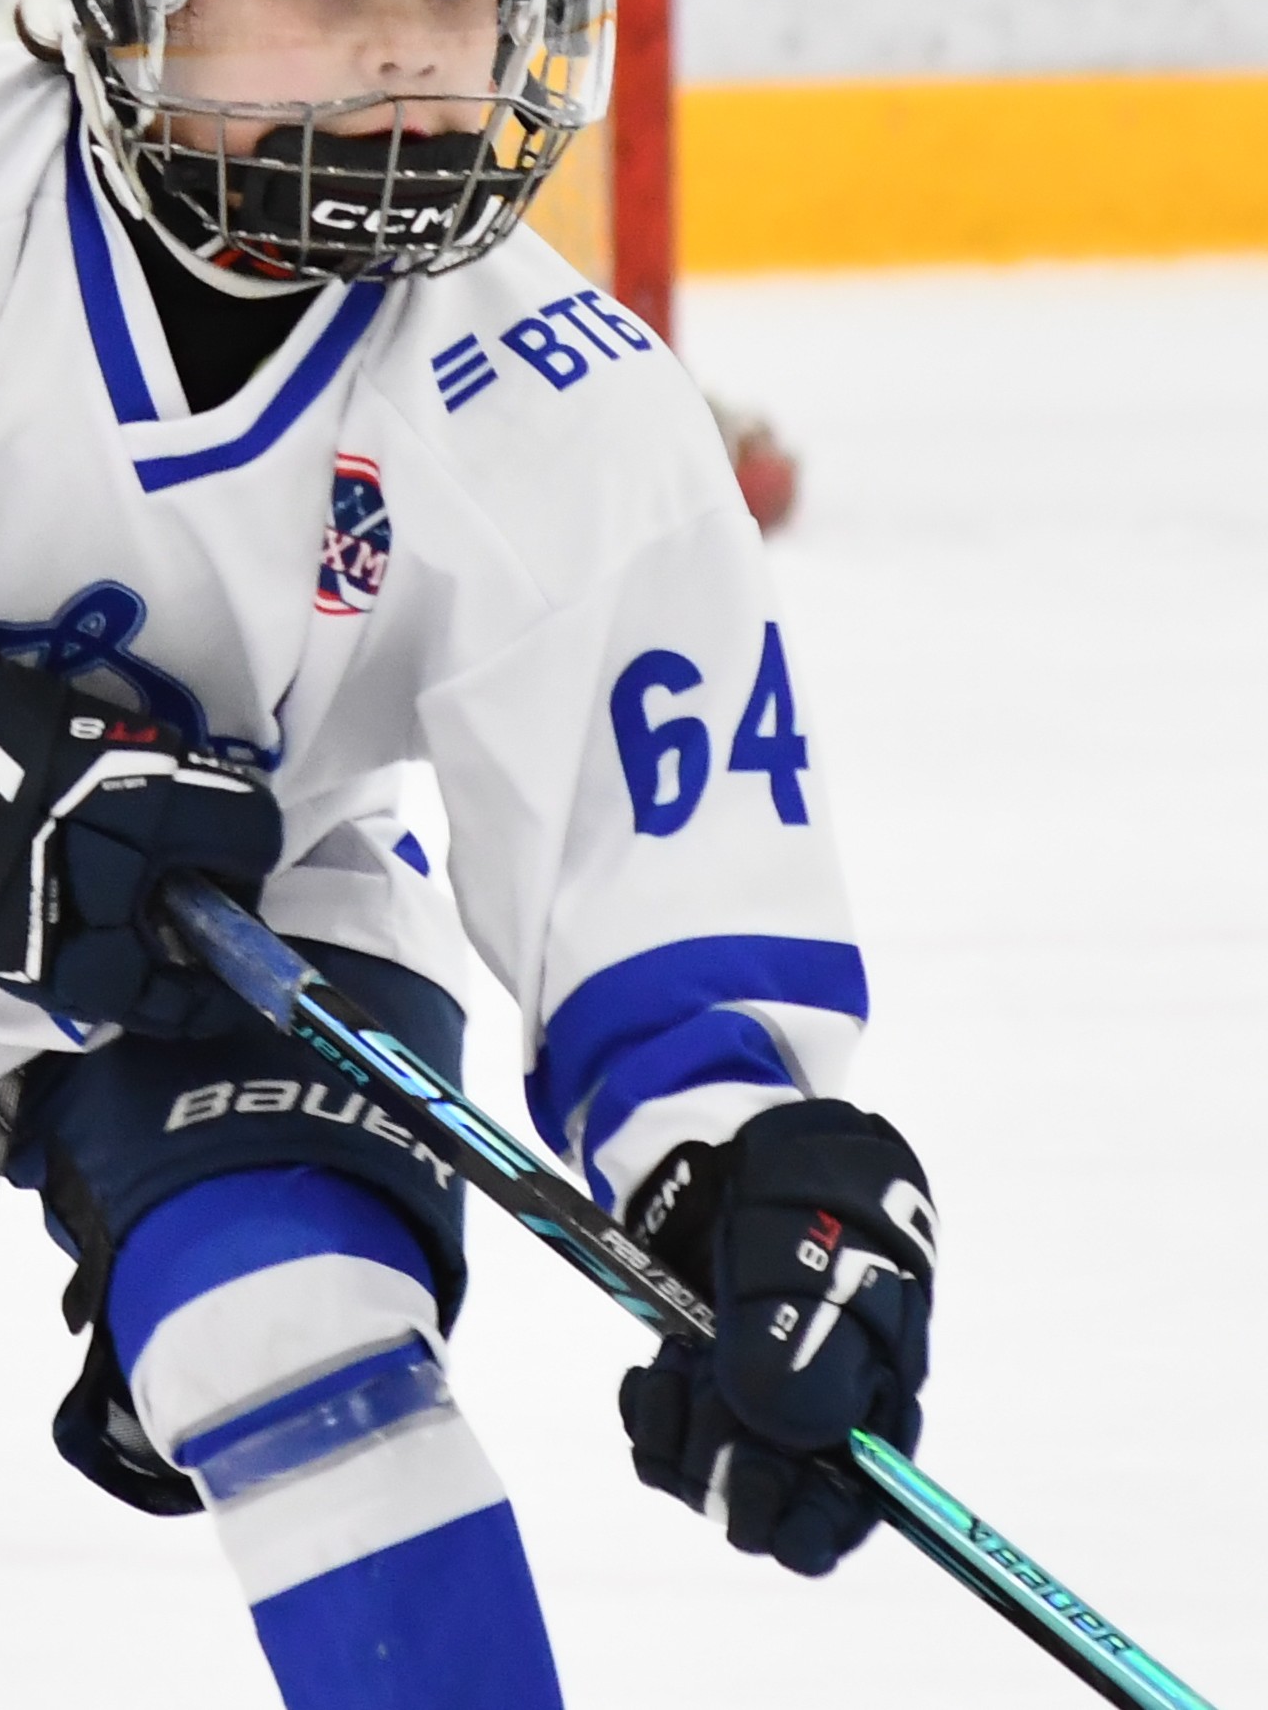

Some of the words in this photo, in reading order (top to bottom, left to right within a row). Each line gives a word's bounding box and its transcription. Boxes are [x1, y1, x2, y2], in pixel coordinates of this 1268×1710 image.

[498, 289, 653, 392] ВТБ
[322, 525, 389, 587] ХМ
[609, 620, 810, 837] 64
